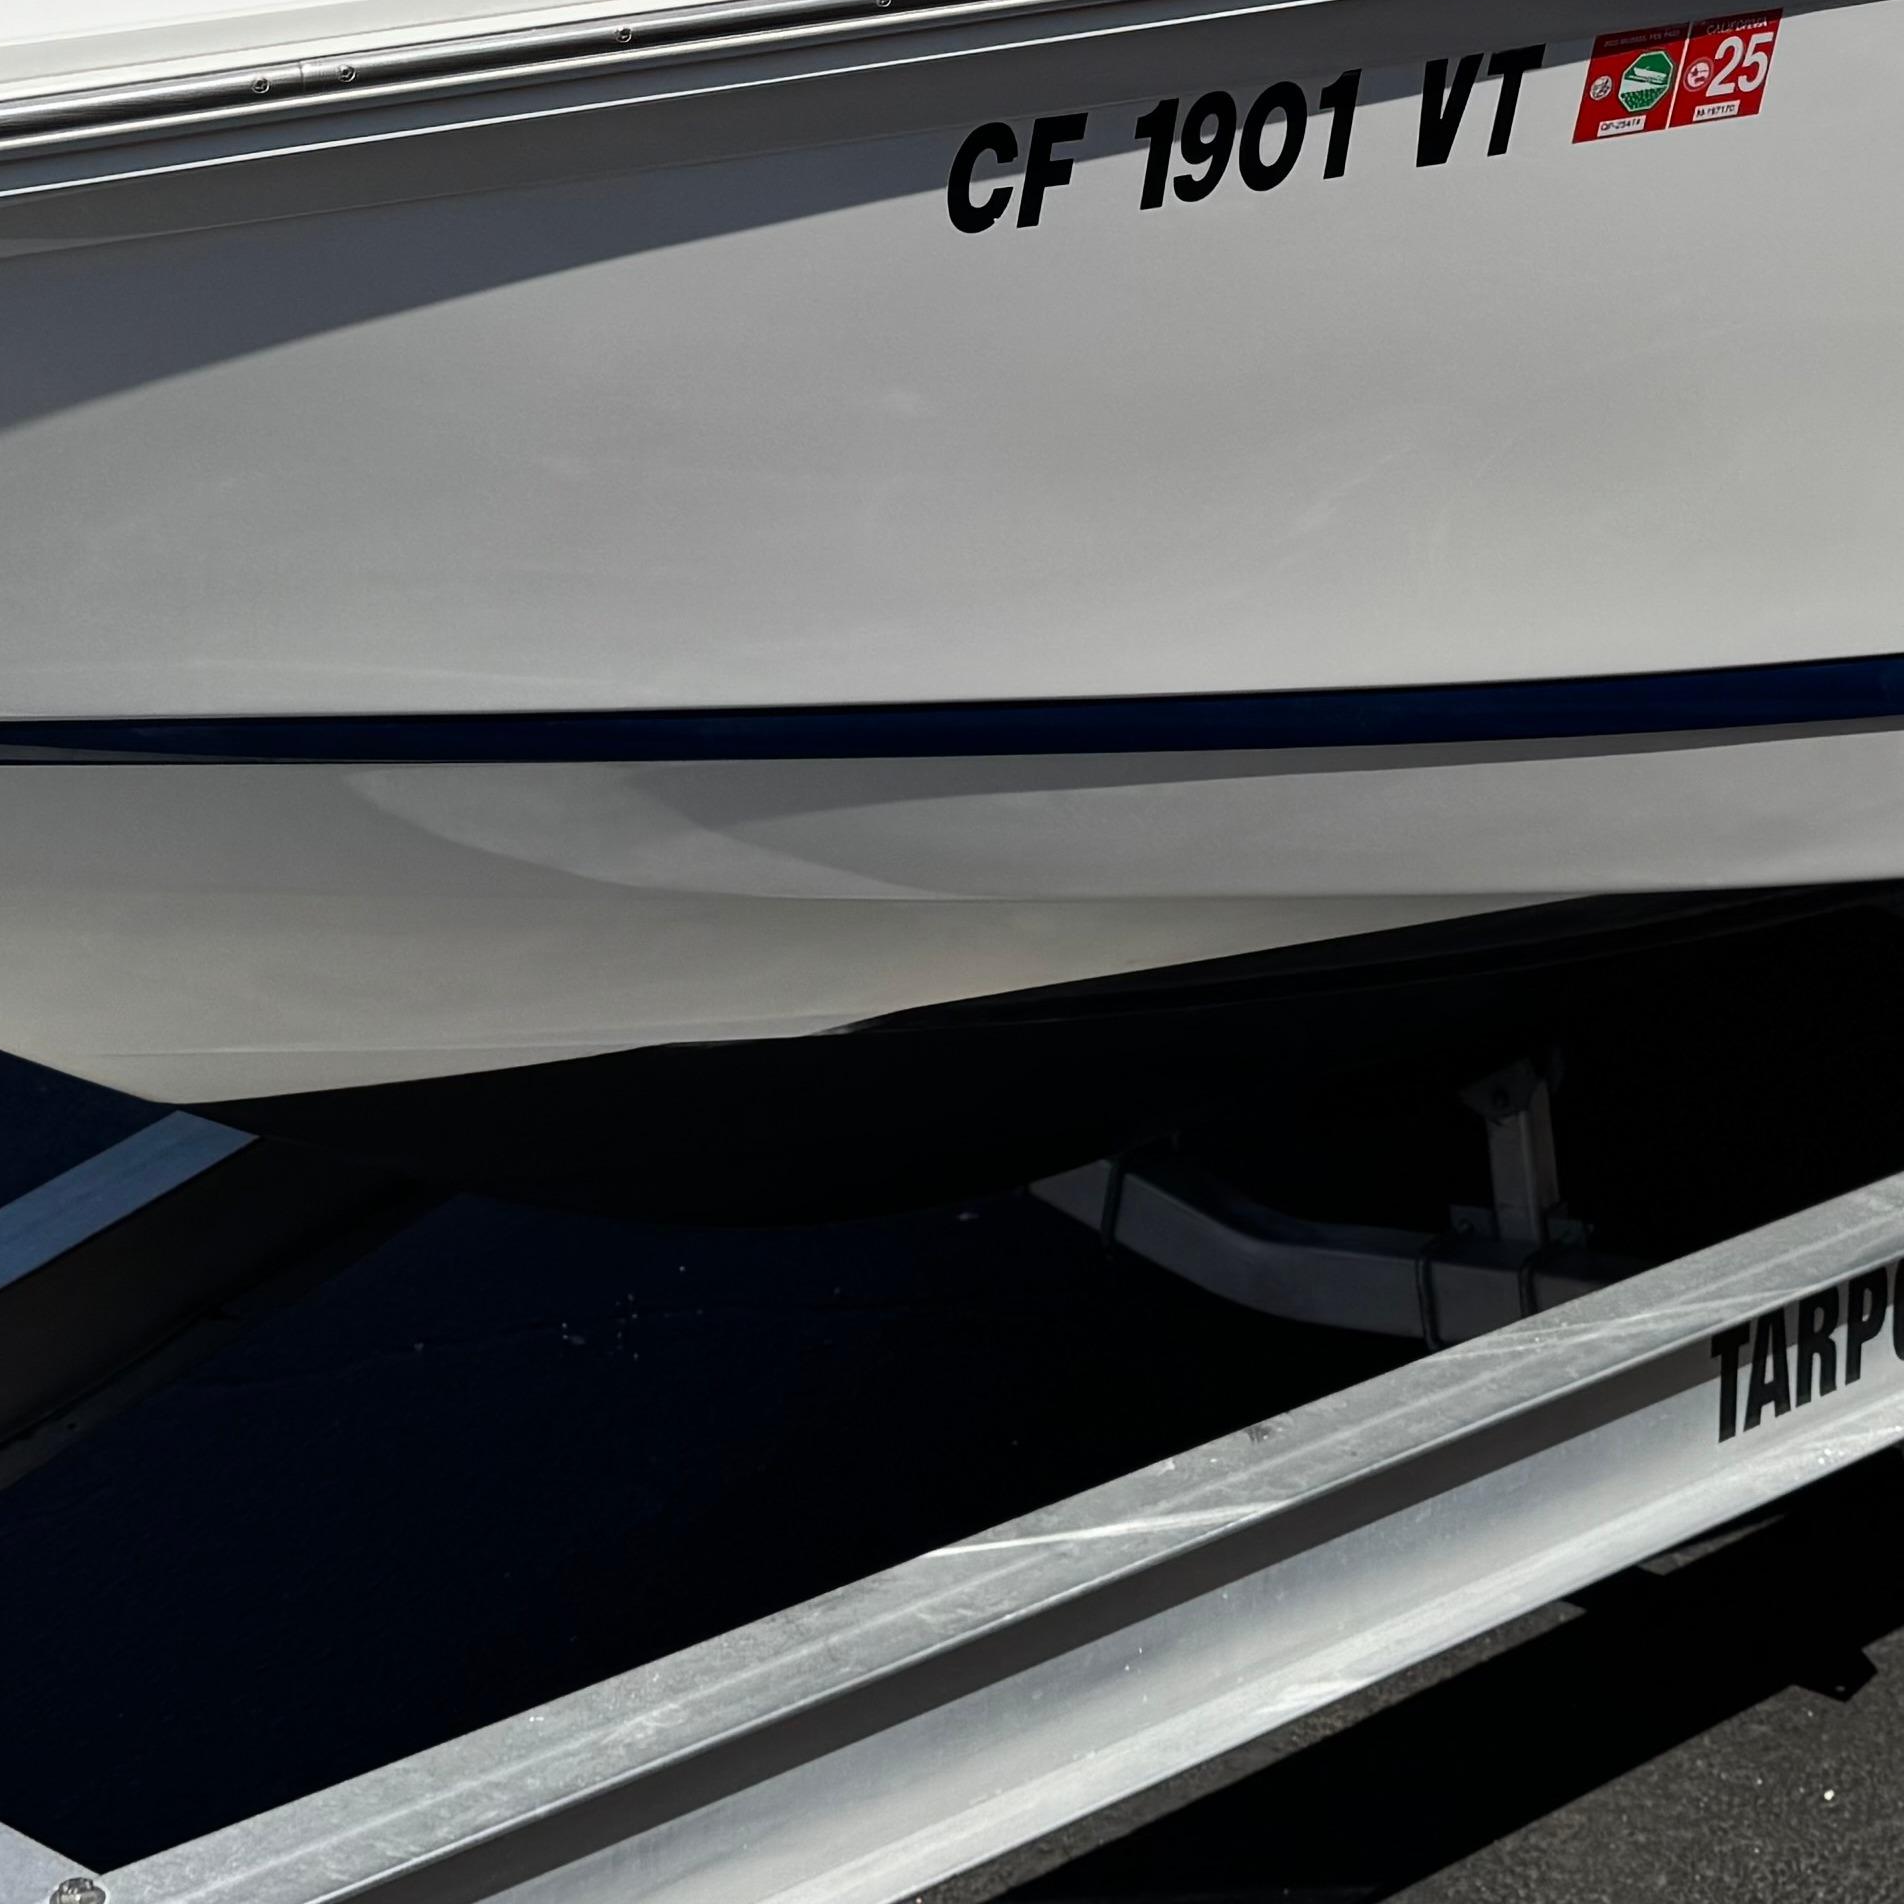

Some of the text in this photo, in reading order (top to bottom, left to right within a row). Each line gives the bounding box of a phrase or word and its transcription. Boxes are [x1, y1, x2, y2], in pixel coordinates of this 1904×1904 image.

[1705, 31, 1774, 97] 25
[946, 44, 1546, 234] CF 1901 VT
